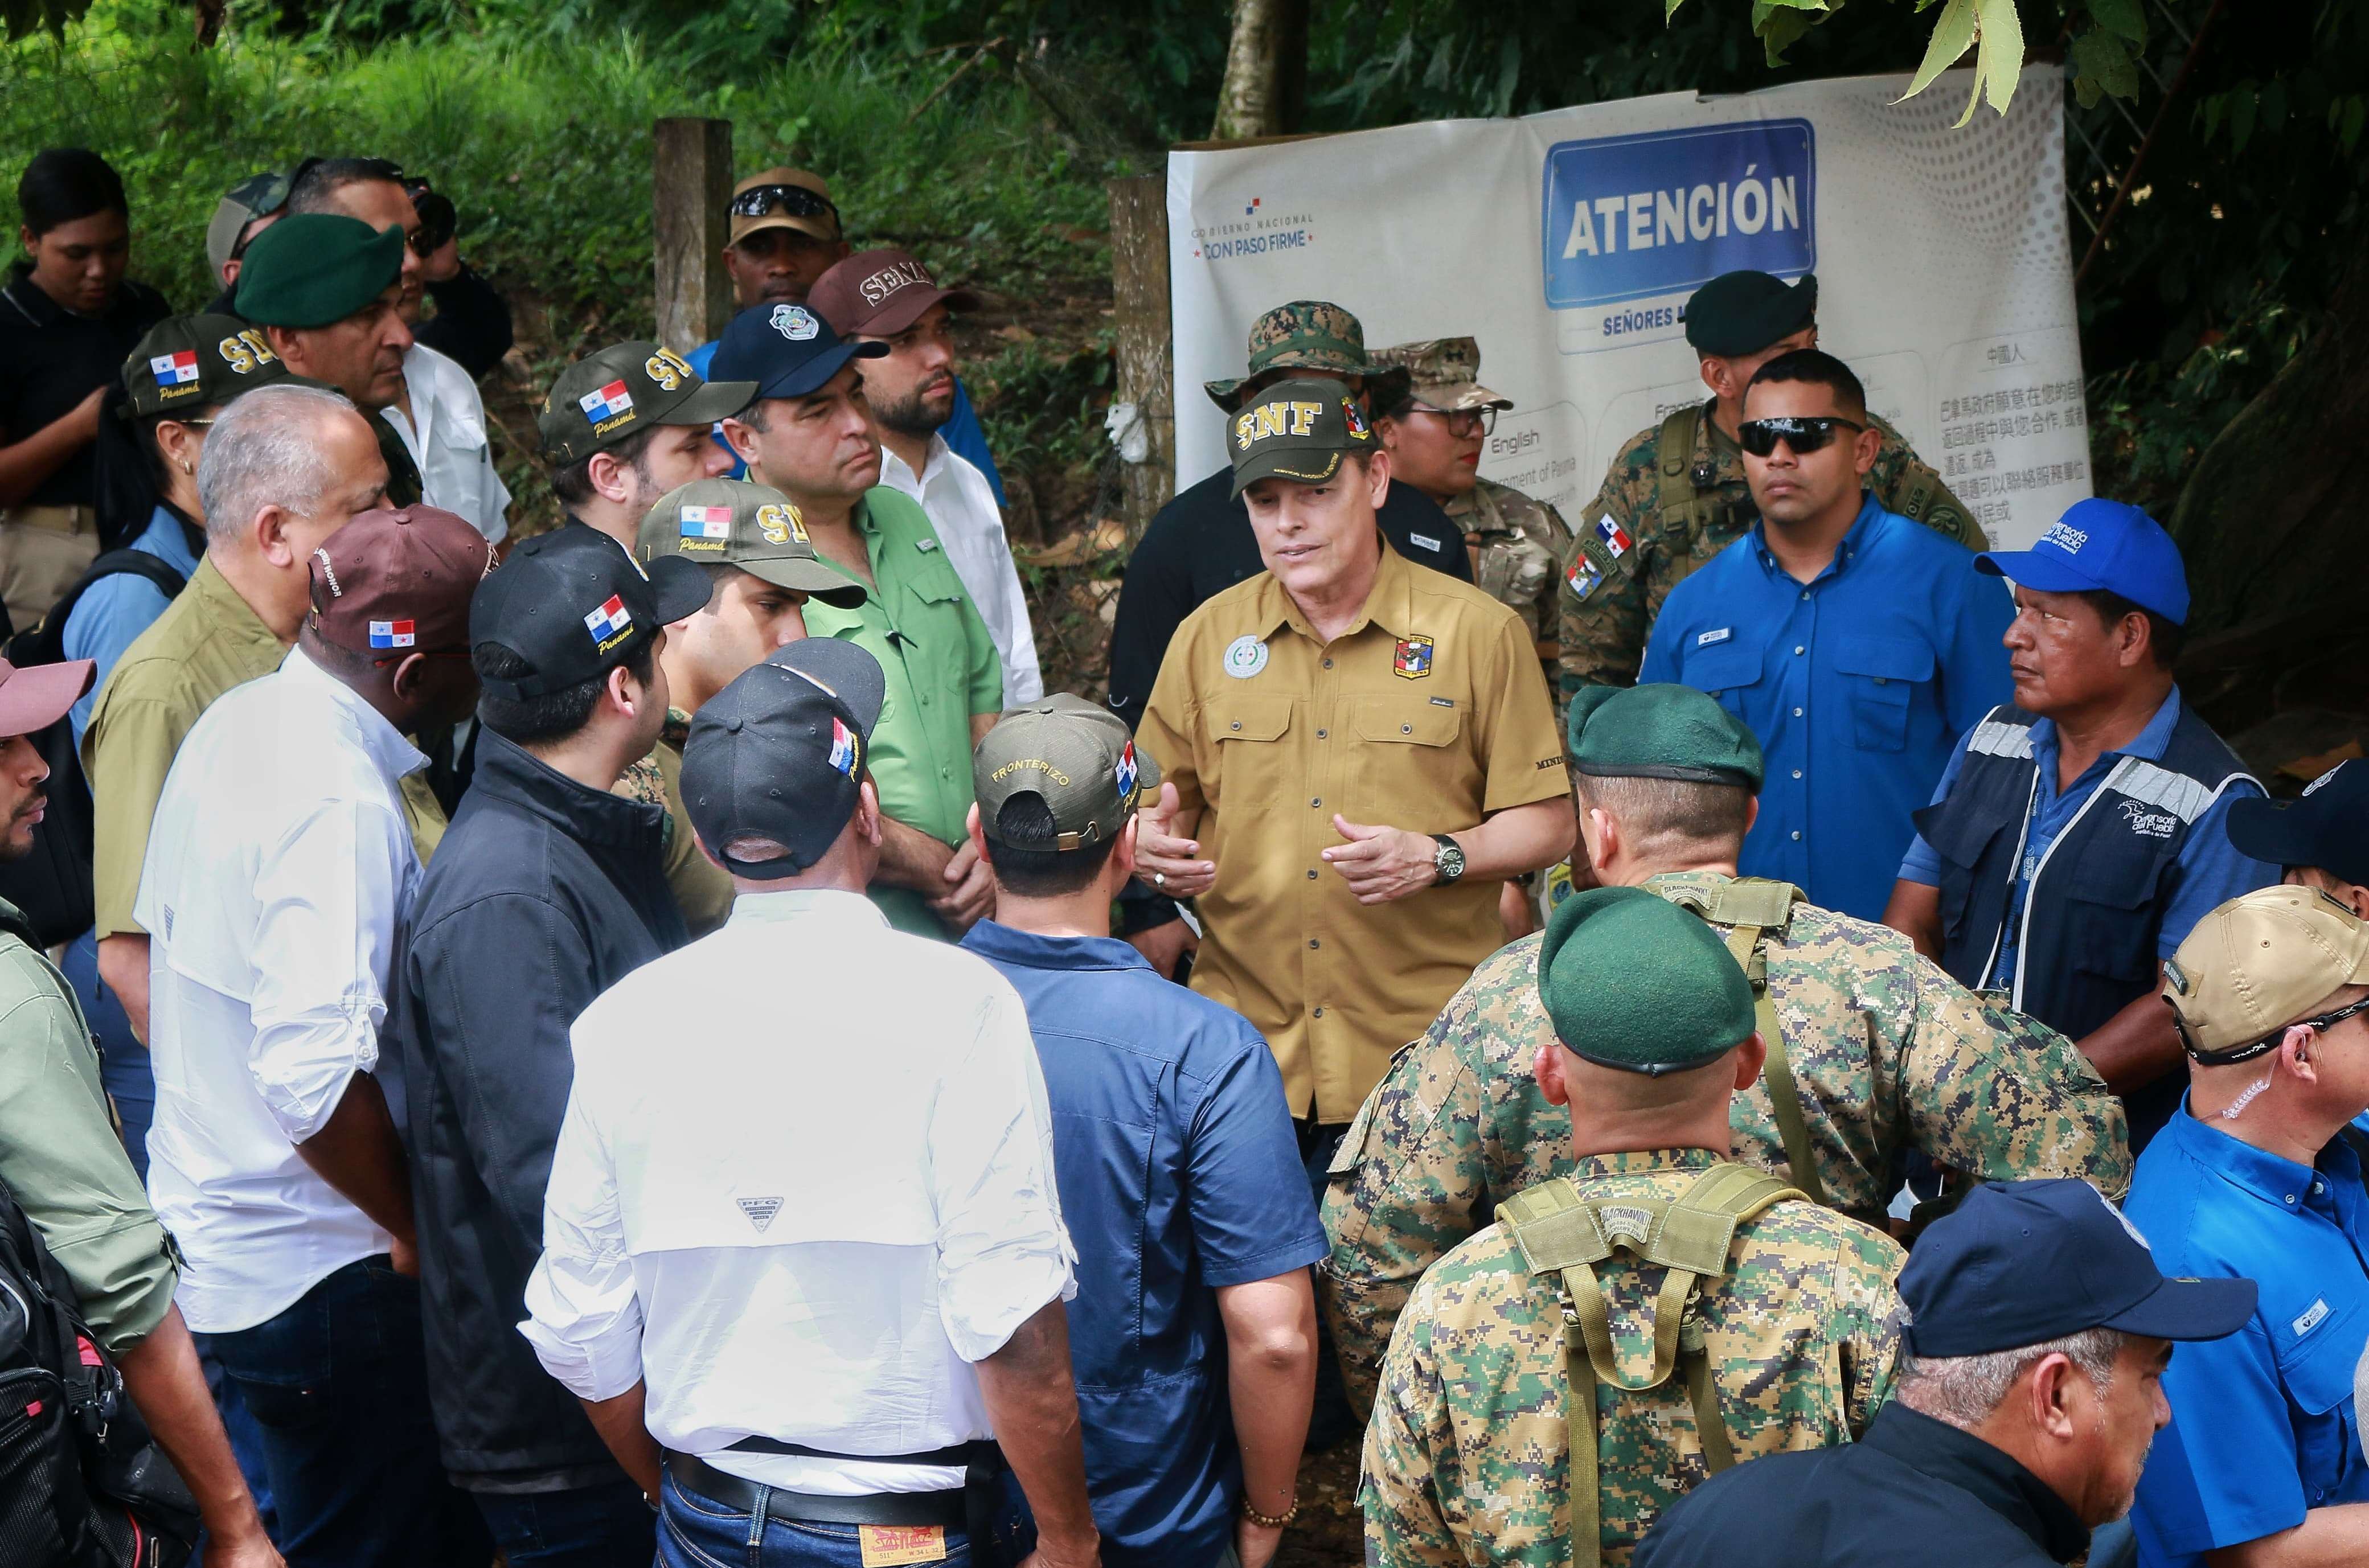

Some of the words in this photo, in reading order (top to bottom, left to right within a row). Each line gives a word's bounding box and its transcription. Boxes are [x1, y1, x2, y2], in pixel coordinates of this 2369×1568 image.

[1191, 224, 1249, 239] GOBIERNO
[1257, 214, 1313, 229] NACIONAL
[1562, 164, 1799, 259] ATENCIÓN
[1204, 242, 1232, 260] CON
[1235, 236, 1266, 256] PASO
[1269, 230, 1305, 251] FIRME
[1602, 306, 1673, 336] SEÑORES
[594, 408, 636, 438] Panamá
[1235, 401, 1322, 451] SNF
[1491, 428, 1539, 454] English
[679, 537, 726, 552] Panamá
[2052, 529, 2081, 549] Pueblo
[323, 565, 342, 597] HONOR
[598, 622, 634, 656] Panamá
[991, 759, 1069, 786] FRONTERIZO
